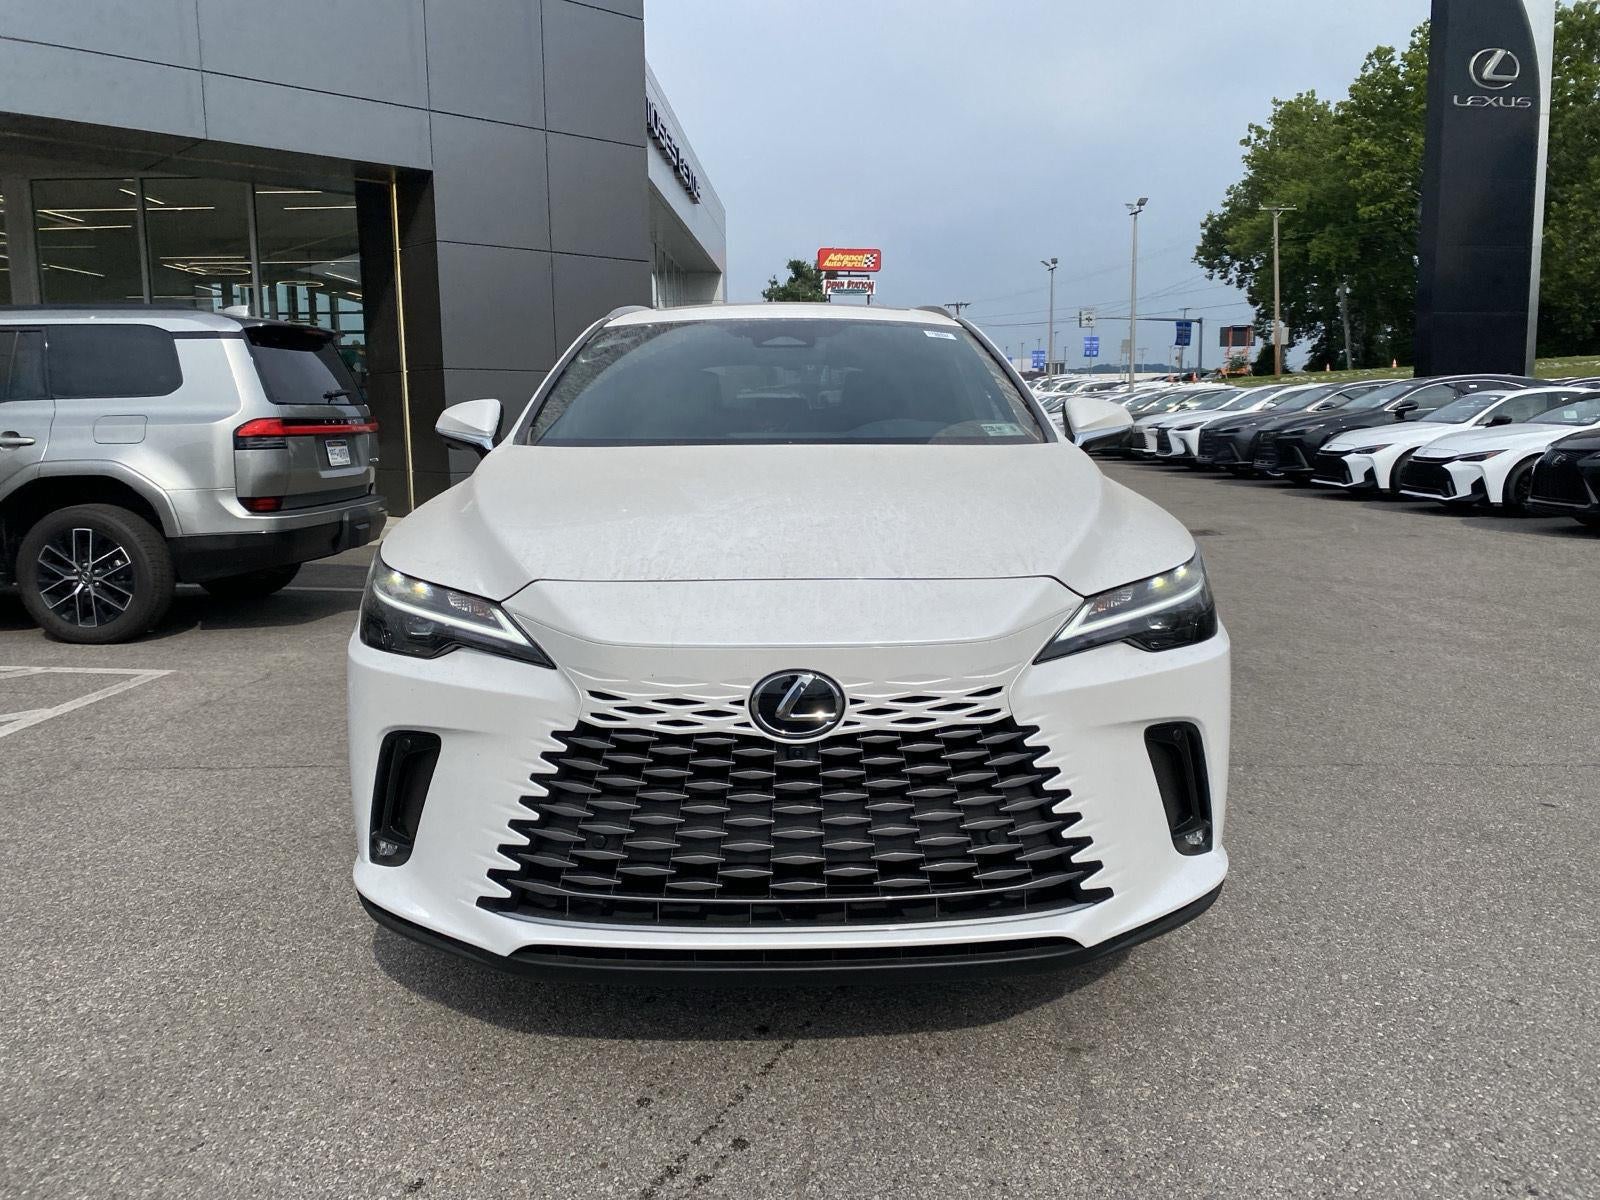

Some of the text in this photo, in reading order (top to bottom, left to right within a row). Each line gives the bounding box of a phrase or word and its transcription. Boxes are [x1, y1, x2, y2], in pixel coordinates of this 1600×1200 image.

[1453, 94, 1532, 108] LEXUS
[841, 260, 863, 268] Parts
[846, 280, 875, 295] STATION
